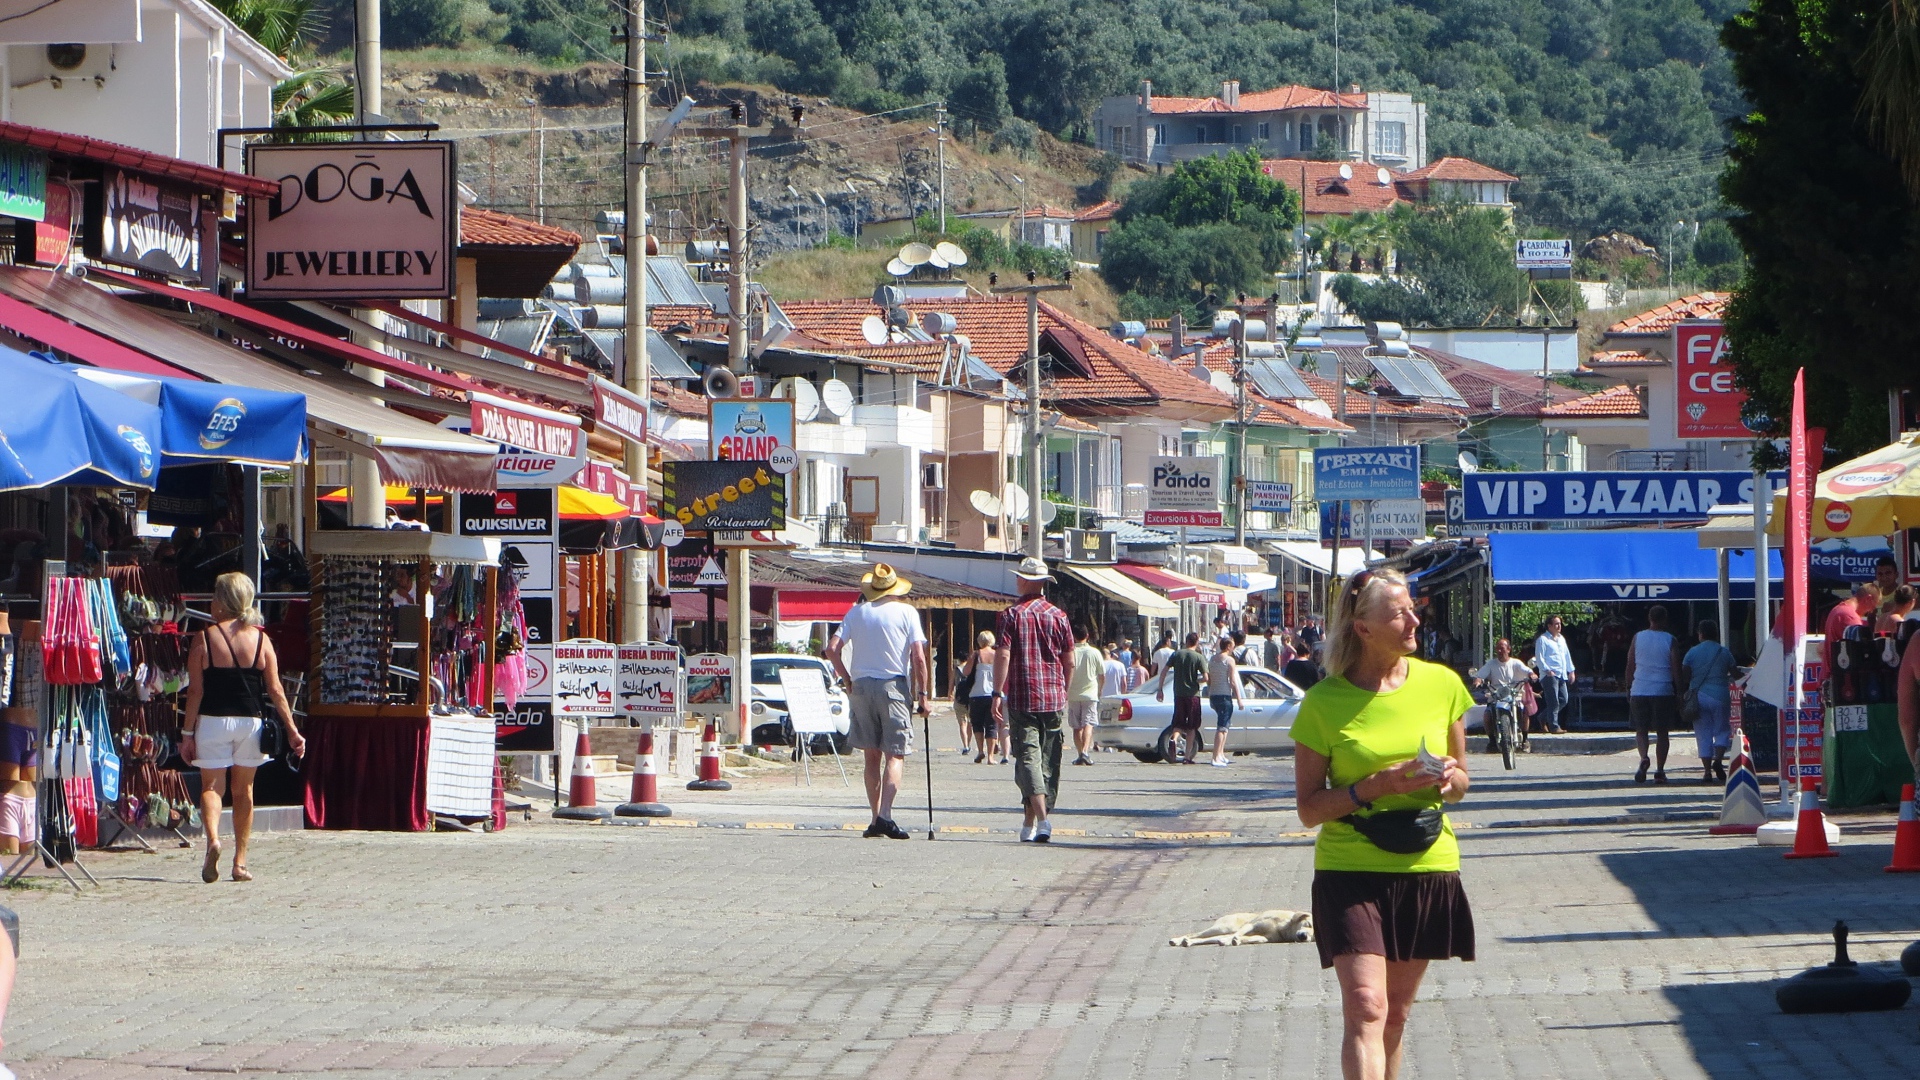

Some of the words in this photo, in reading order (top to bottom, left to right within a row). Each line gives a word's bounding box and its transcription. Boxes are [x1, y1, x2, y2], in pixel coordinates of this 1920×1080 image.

[167, 219, 191, 269] GOLD
[262, 250, 438, 281] JEWELLERY
[1690, 371, 1739, 393] CE
[207, 412, 242, 432] EFES
[537, 423, 544, 452] &
[544, 425, 573, 457] WATCH
[717, 436, 779, 461] GRAND
[772, 456, 794, 464] BAR
[1153, 466, 1211, 489] Panda
[1340, 467, 1389, 477] EMLAK
[1255, 483, 1289, 492] NURHAL
[1318, 479, 1337, 489] Real
[1338, 479, 1363, 489] Estate
[676, 466, 771, 525] street
[1477, 480, 1547, 515] VIP
[1563, 479, 1722, 515] BAZAAR
[1259, 500, 1283, 508] APART
[704, 516, 772, 527] Restaurant
[1147, 513, 1188, 523] Excursions
[1190, 514, 1196, 524] &
[1199, 514, 1219, 524] Tours
[1393, 513, 1420, 523] TAXI
[465, 518, 547, 532] QUIKSILVER
[664, 529, 684, 537] AFE
[718, 530, 745, 541] TEXTILES
[700, 572, 723, 580] HOTEL
[1612, 584, 1670, 598] VIP
[1, 652, 14, 706] Superdry
[1786, 711, 1823, 721] BAR
